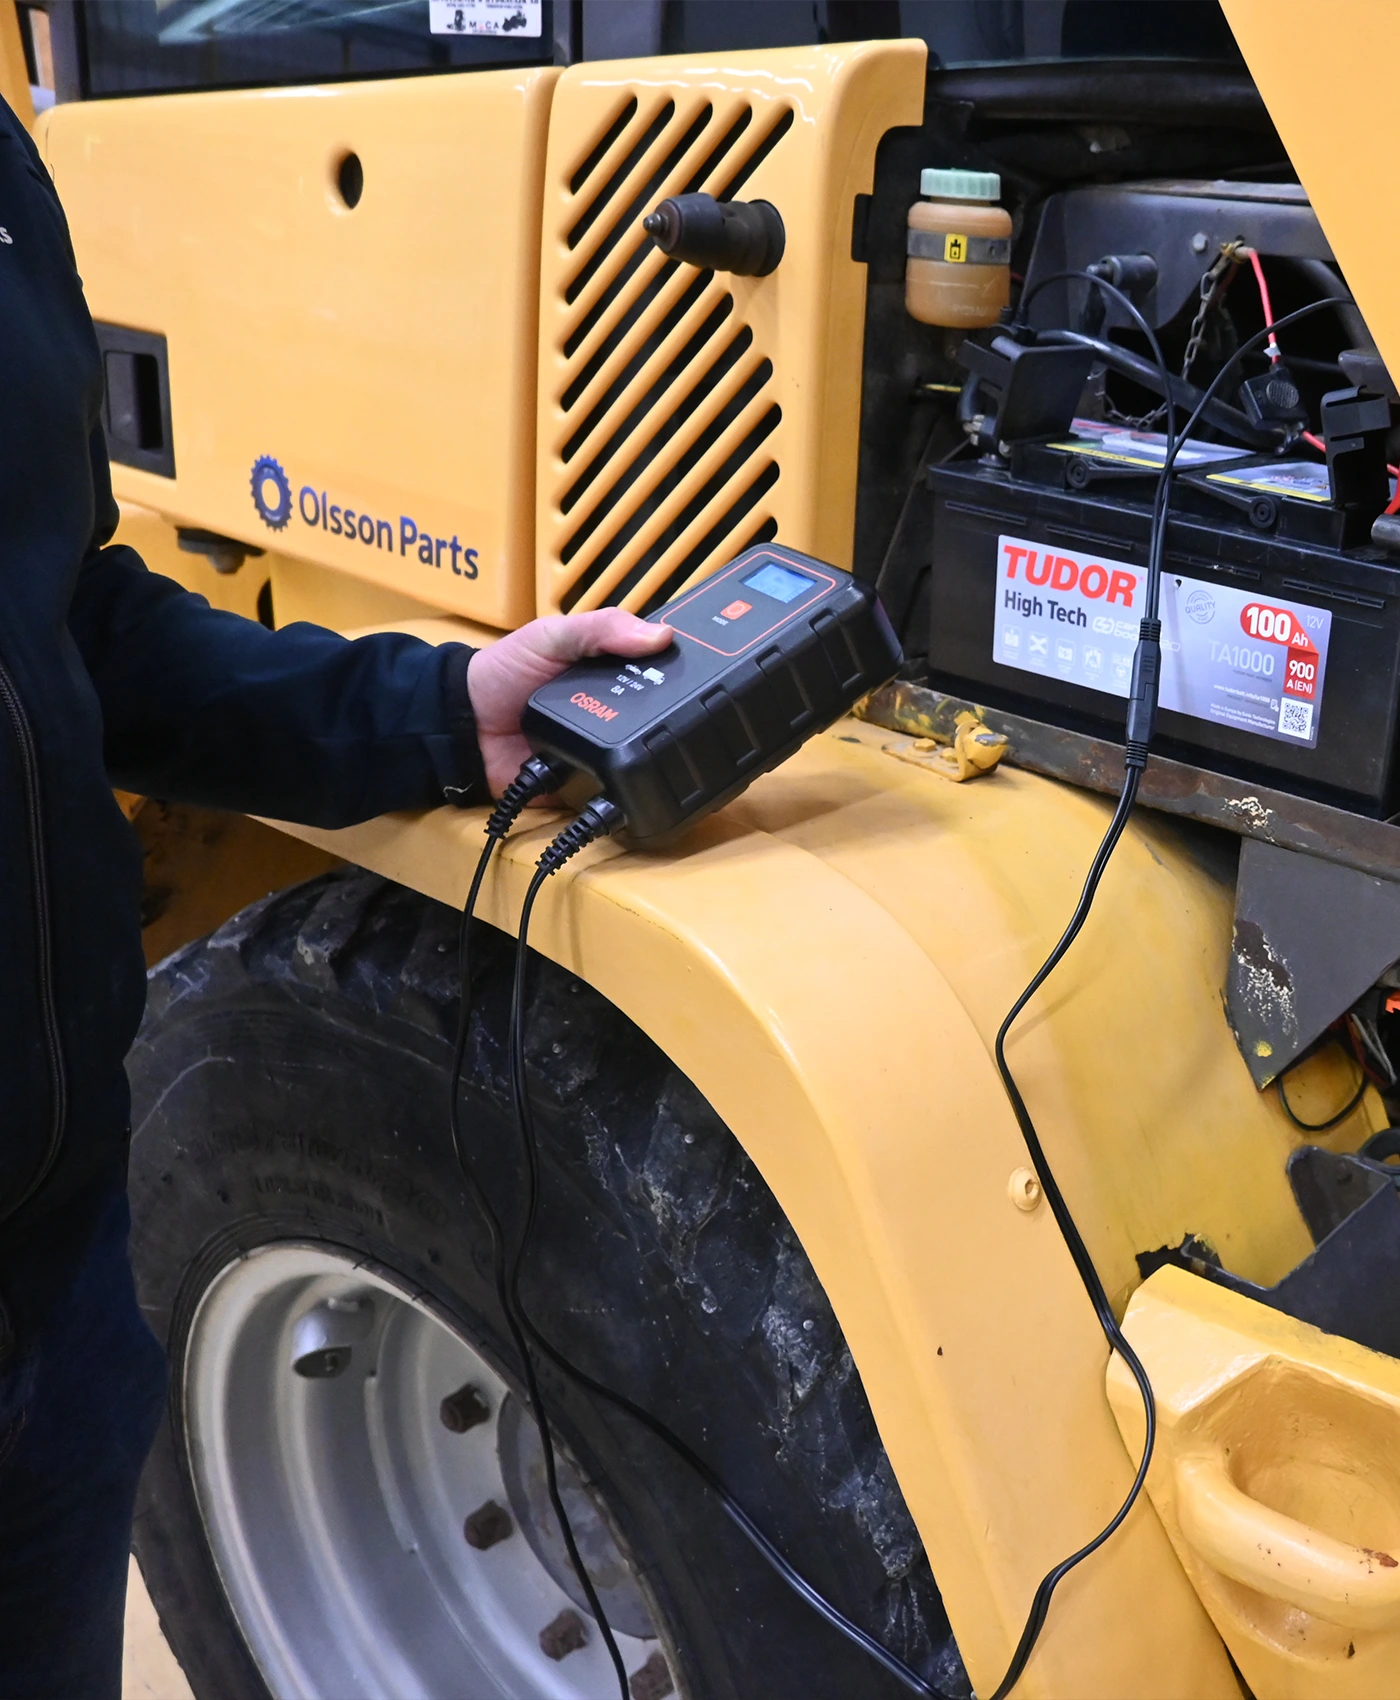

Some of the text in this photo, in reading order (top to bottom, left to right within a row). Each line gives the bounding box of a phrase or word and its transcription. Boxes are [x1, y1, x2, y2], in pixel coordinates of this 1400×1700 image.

[299, 486, 479, 580] Olsson Parts
[1004, 545, 1137, 608] TUDOR
[1004, 589, 1087, 628] High Tech
[1185, 601, 1216, 614] QUALITY
[1246, 606, 1309, 647] 100 Ah
[1306, 614, 1324, 630] 12V
[1208, 638, 1275, 676] TA1000
[1288, 659, 1315, 681] 900
[570, 692, 619, 722] OSRAM
